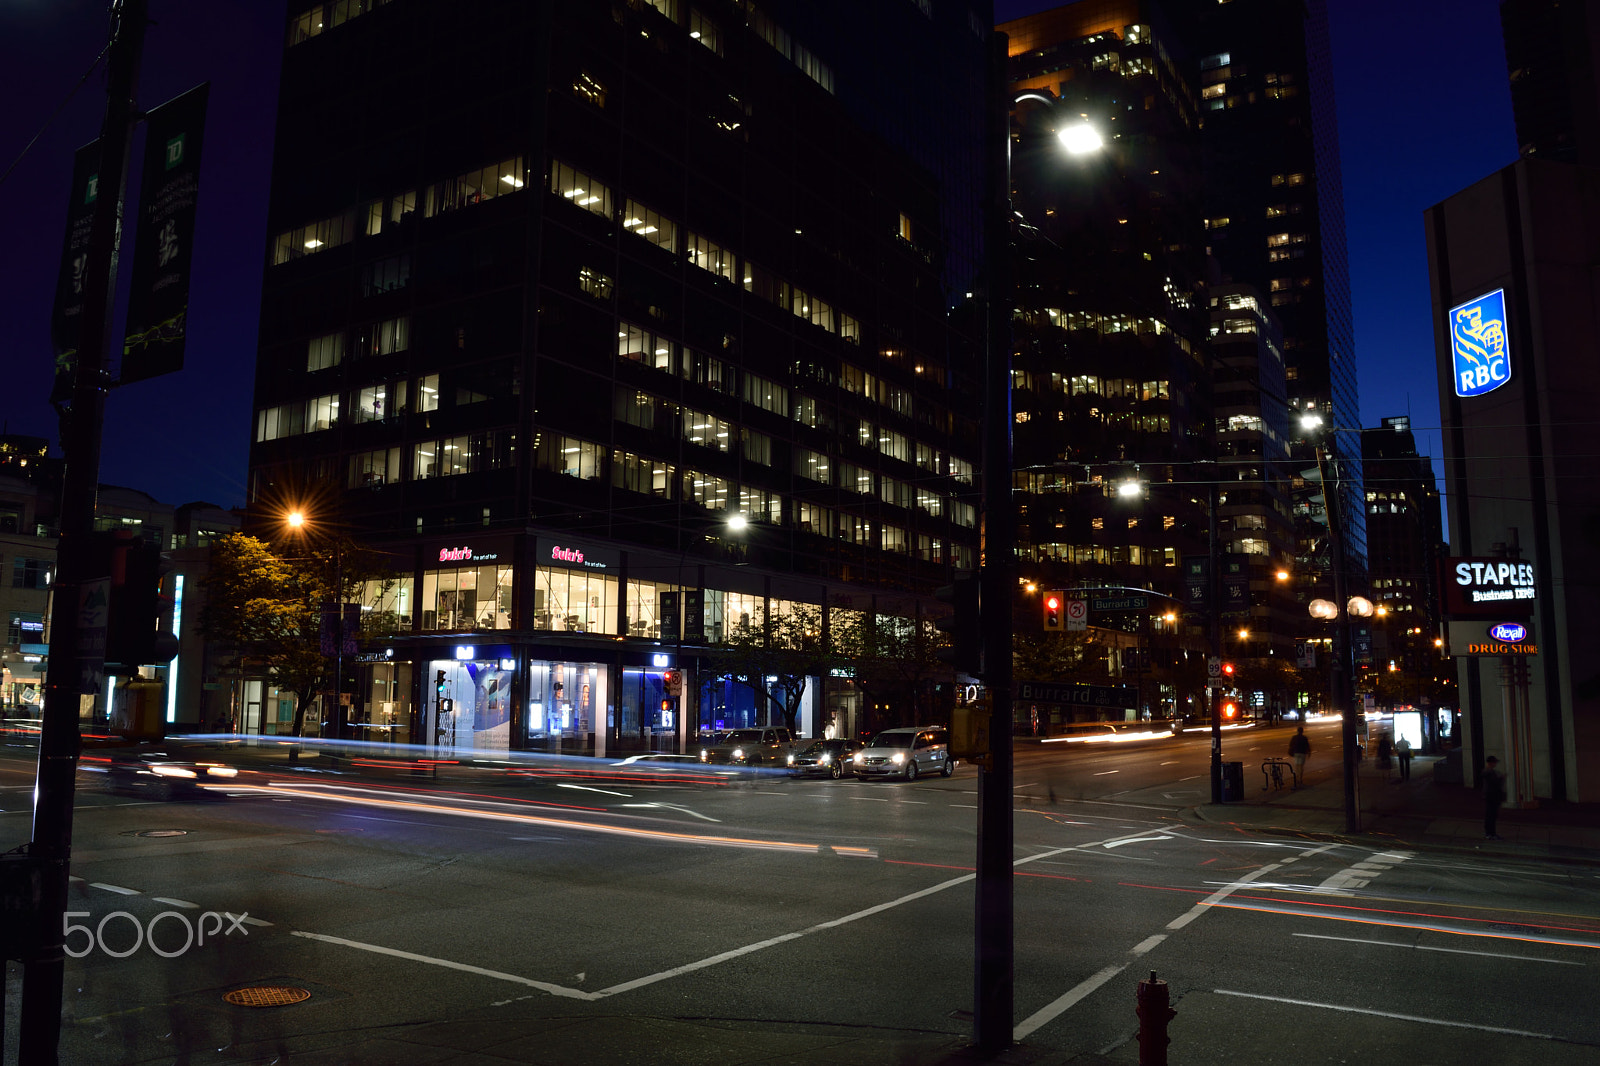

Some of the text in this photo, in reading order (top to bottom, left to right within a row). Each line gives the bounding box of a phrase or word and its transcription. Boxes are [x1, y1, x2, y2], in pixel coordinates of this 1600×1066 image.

[167, 140, 182, 165] TD
[1460, 359, 1505, 392] RBC
[439, 546, 473, 562] Suki's
[551, 545, 584, 563] Suki's
[1456, 562, 1534, 586] STAPLES
[1095, 598, 1144, 609] Burrard St
[1472, 589, 1514, 603] Business
[1496, 625, 1524, 641] Rexall
[1468, 643, 1538, 655] DRUG STORE
[1209, 664, 1220, 673] 99
[1022, 684, 1091, 704] Burrard
